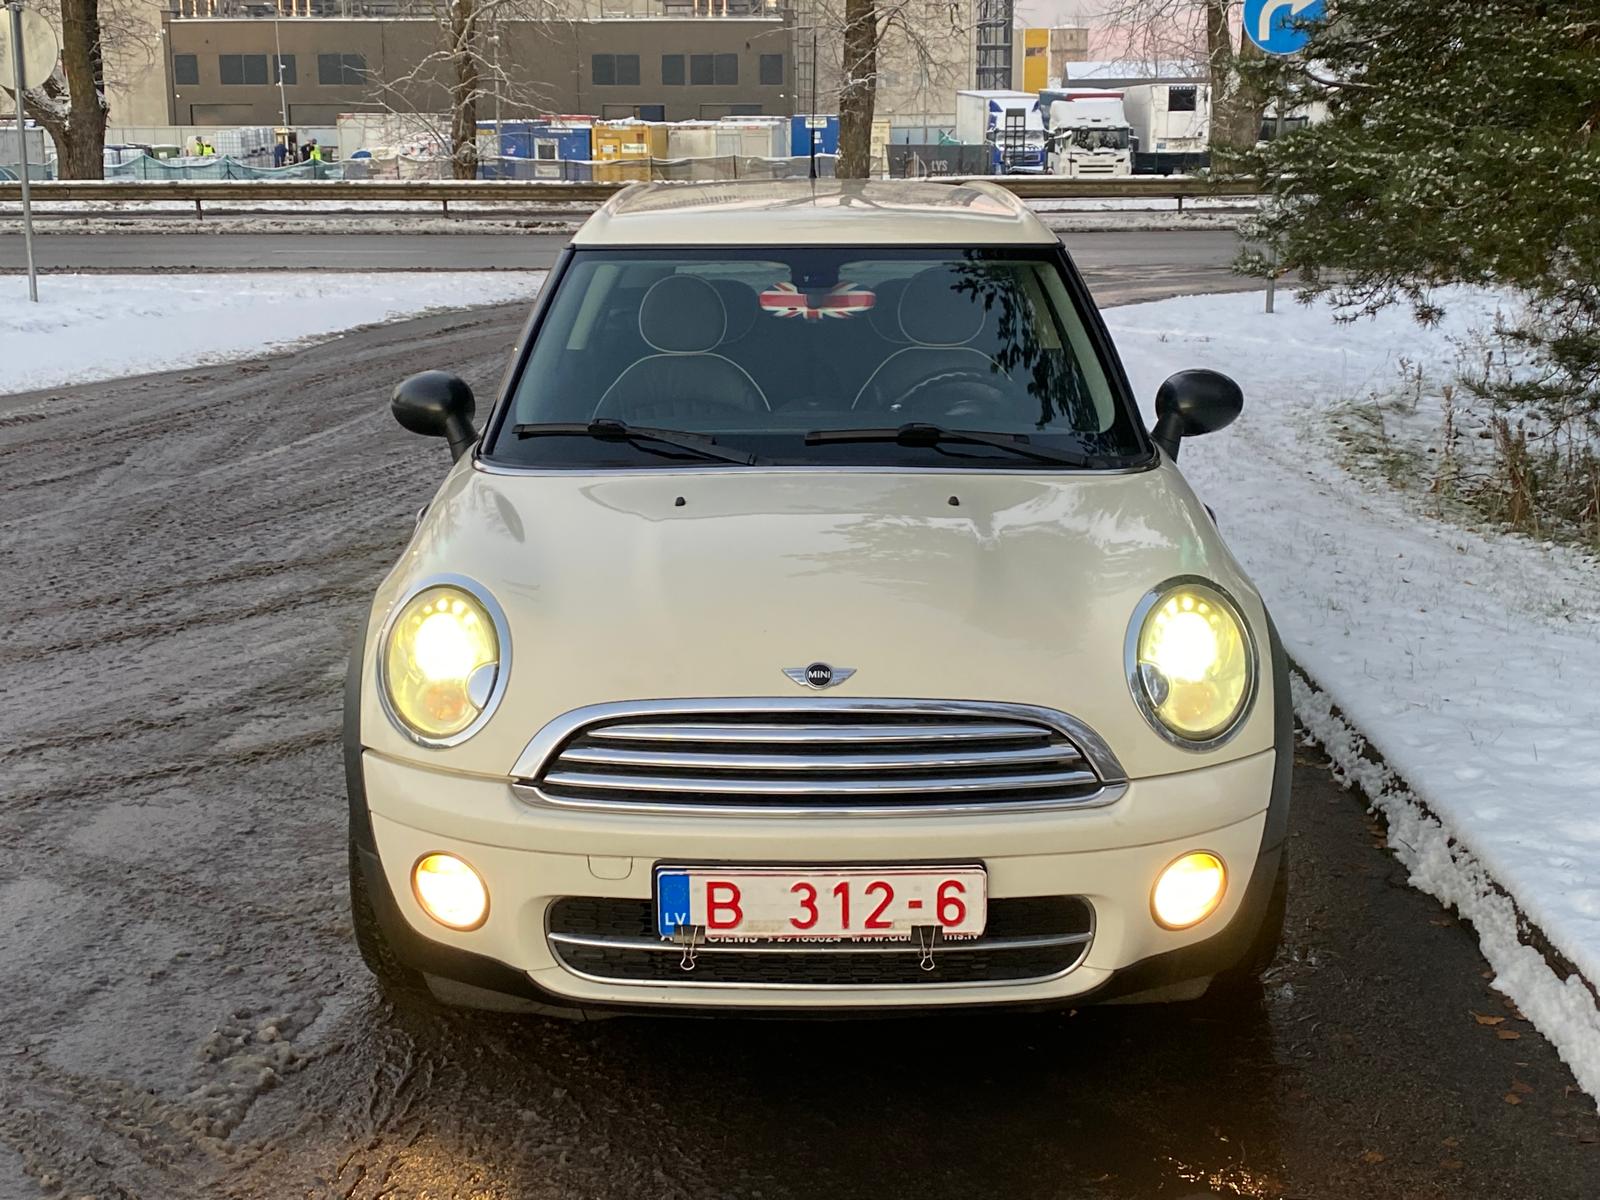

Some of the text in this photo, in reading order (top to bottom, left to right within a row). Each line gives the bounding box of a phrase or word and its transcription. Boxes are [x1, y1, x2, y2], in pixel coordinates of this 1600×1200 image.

[931, 160, 948, 172] LYS
[808, 670, 831, 679] MINI
[706, 880, 967, 930] B 312-6
[664, 912, 687, 926] LV
